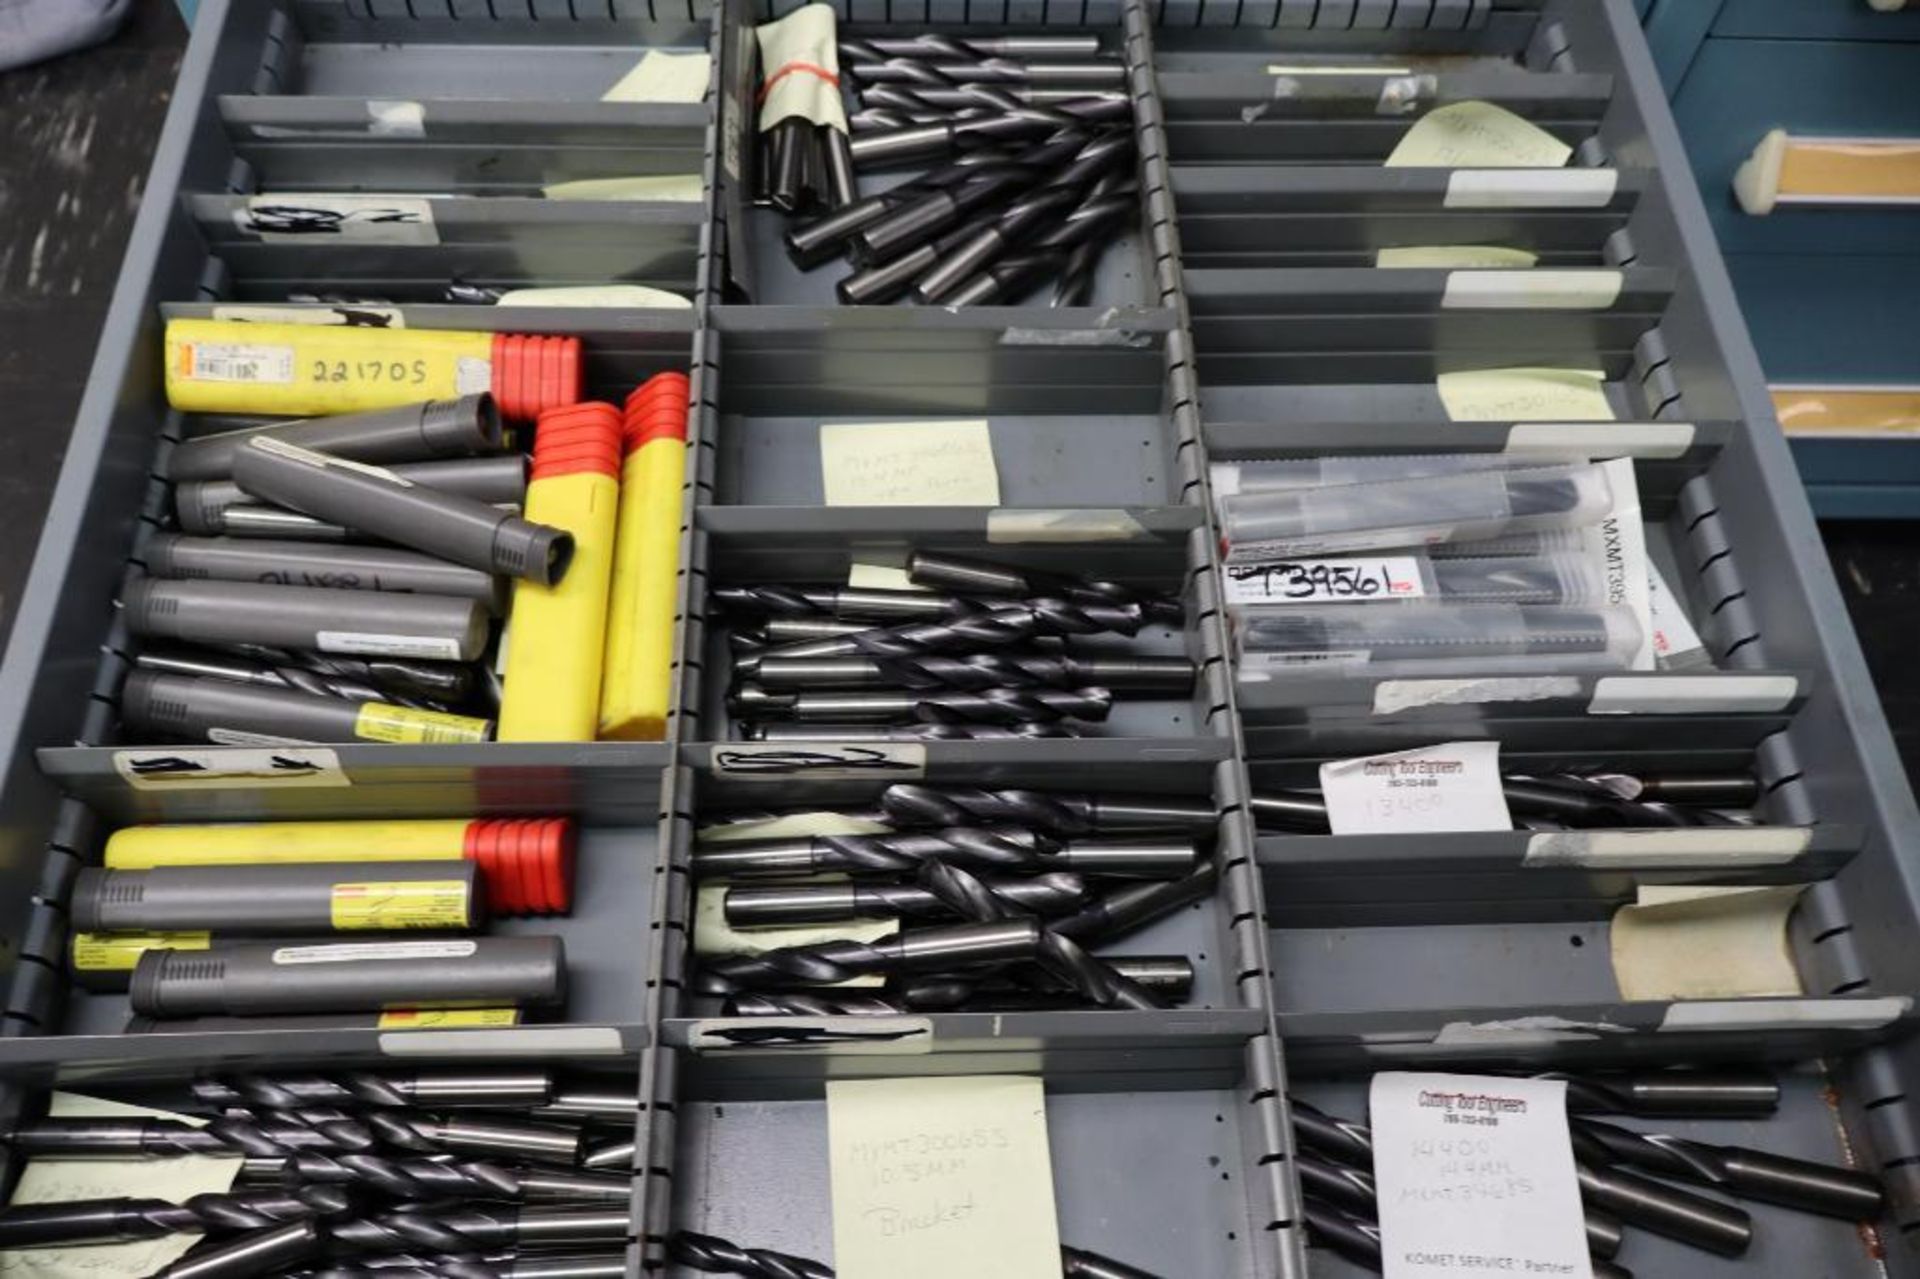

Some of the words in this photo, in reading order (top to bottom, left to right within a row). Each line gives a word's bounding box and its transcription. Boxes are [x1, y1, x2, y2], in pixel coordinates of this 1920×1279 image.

[1477, 1095, 1528, 1115] Engineers
[1405, 1252, 1456, 1267] KOMET
[1524, 1259, 1574, 1274] Partner
